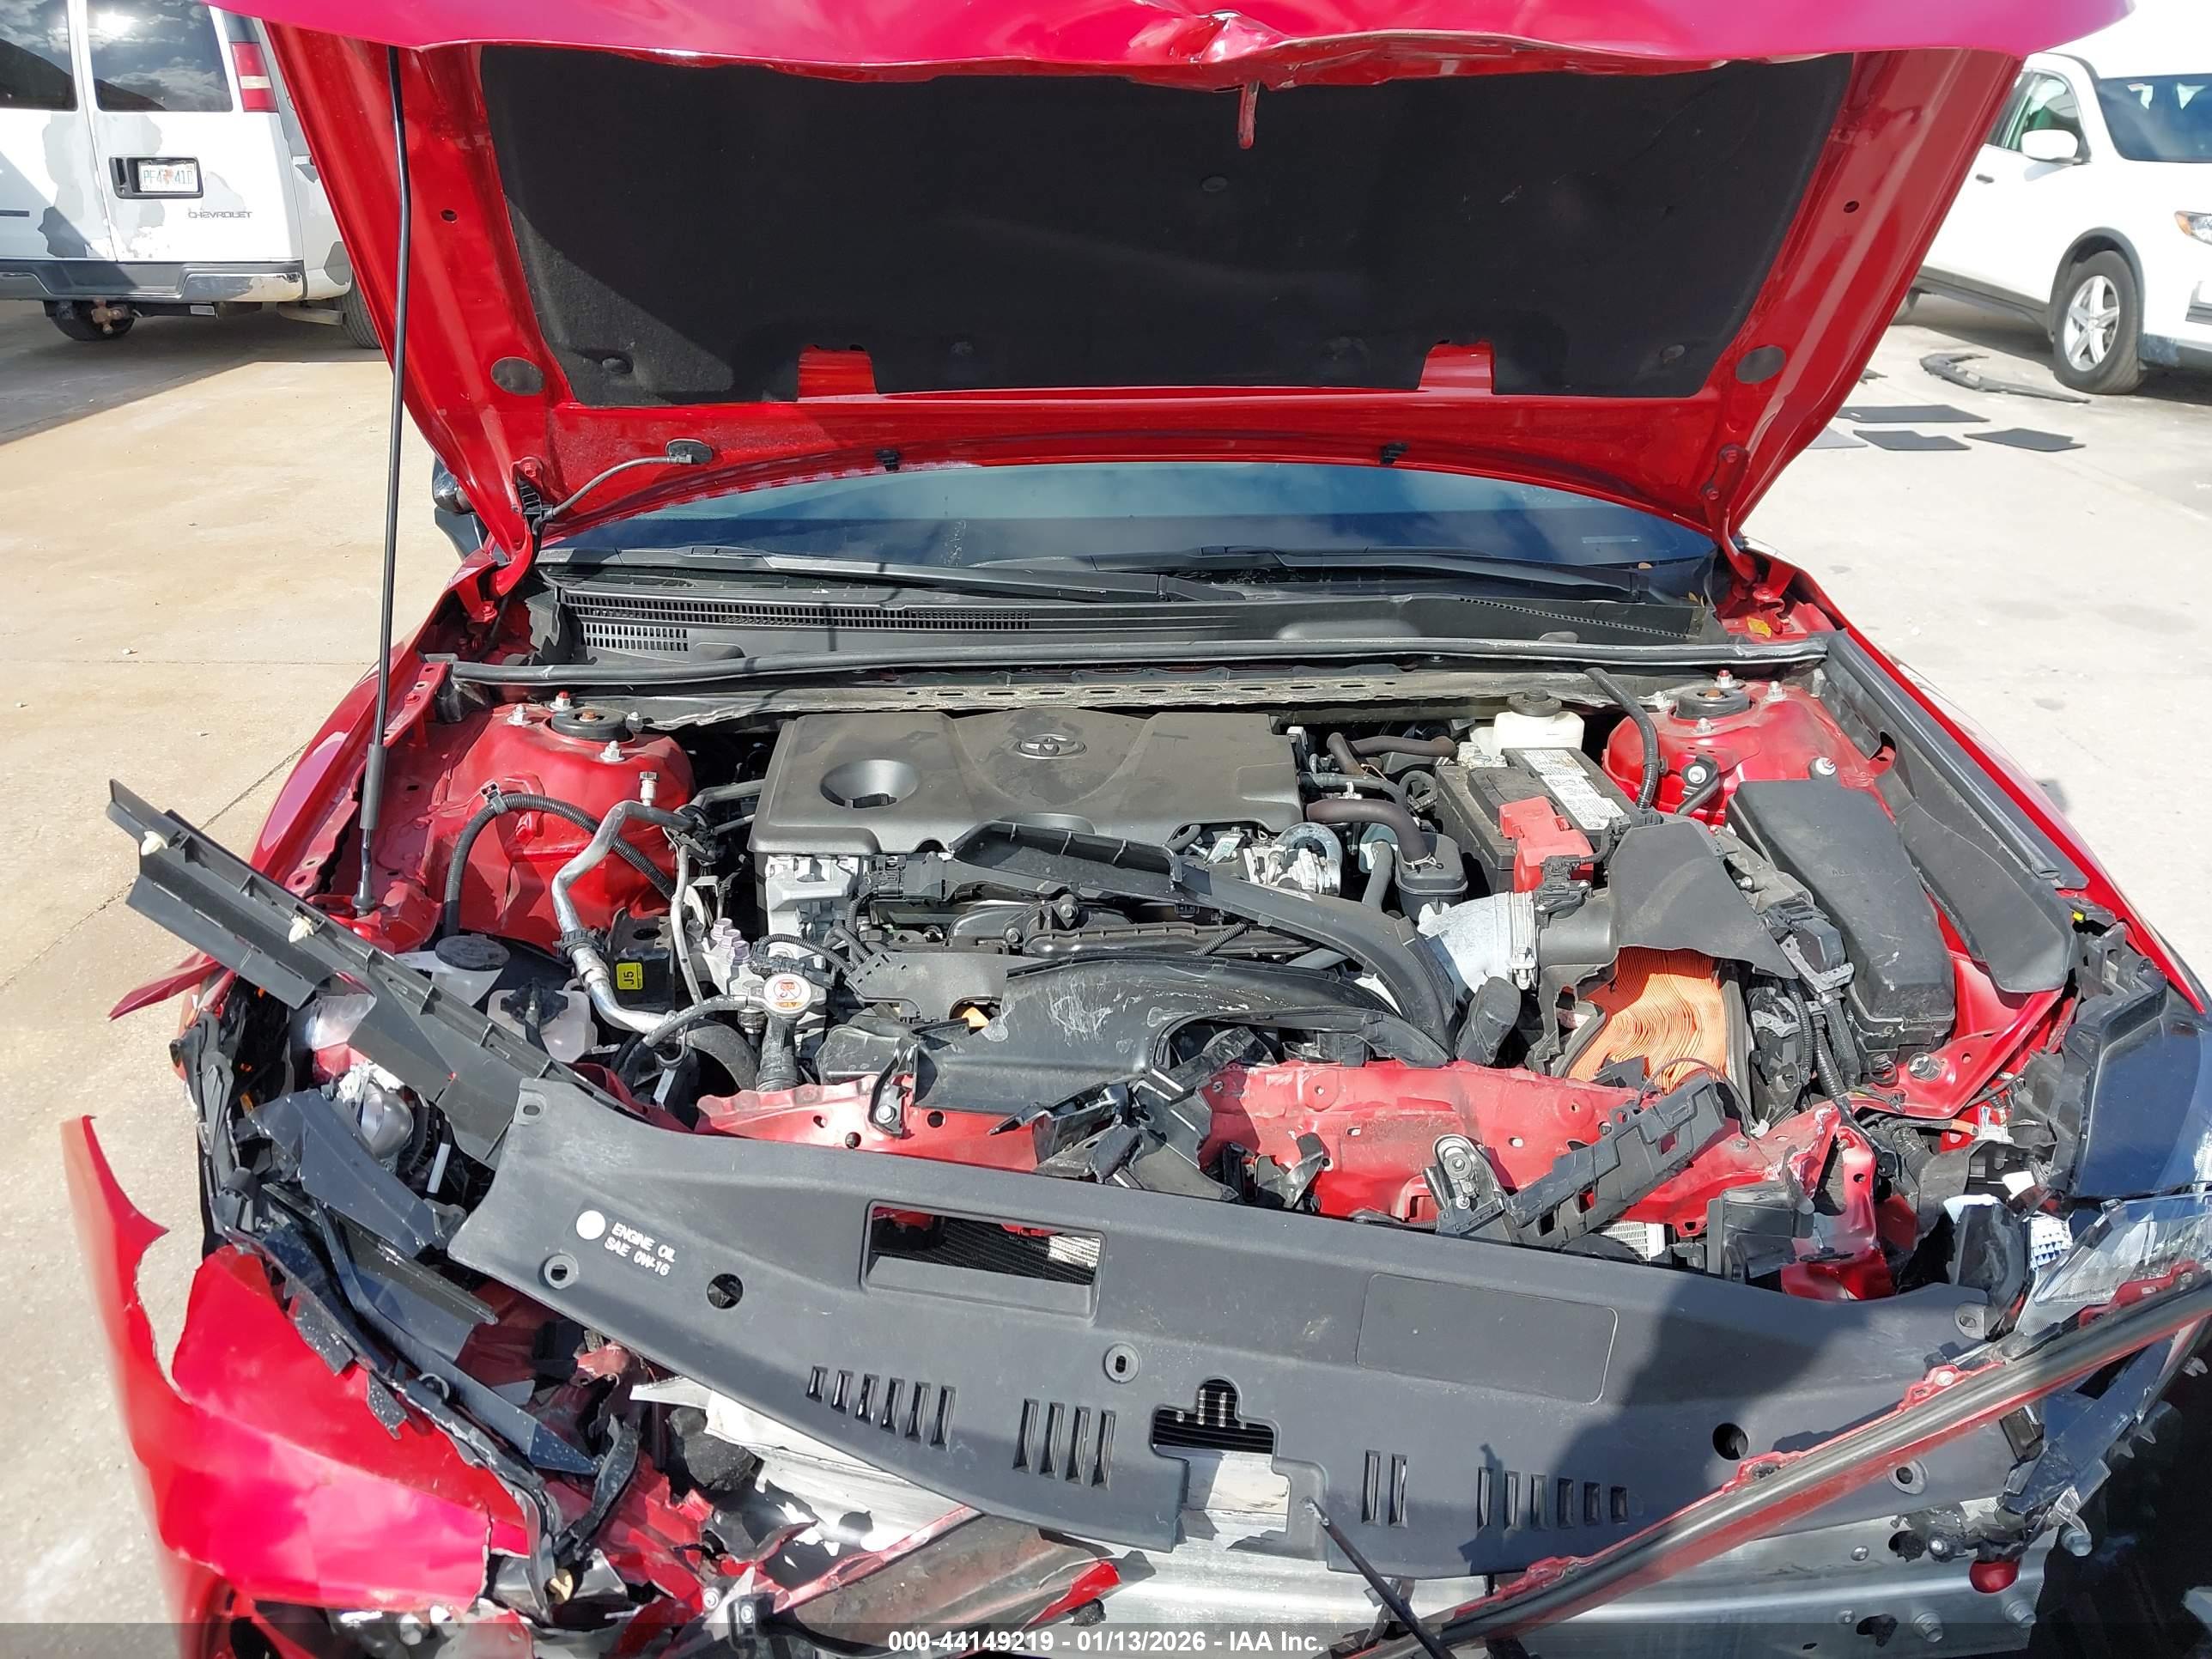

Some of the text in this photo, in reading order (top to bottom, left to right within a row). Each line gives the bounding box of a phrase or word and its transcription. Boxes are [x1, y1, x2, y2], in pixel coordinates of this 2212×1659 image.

[623, 971, 635, 985] J5
[604, 1237, 671, 1276] SAE 0W-16
[611, 1222, 676, 1262] ENGINE OIL
